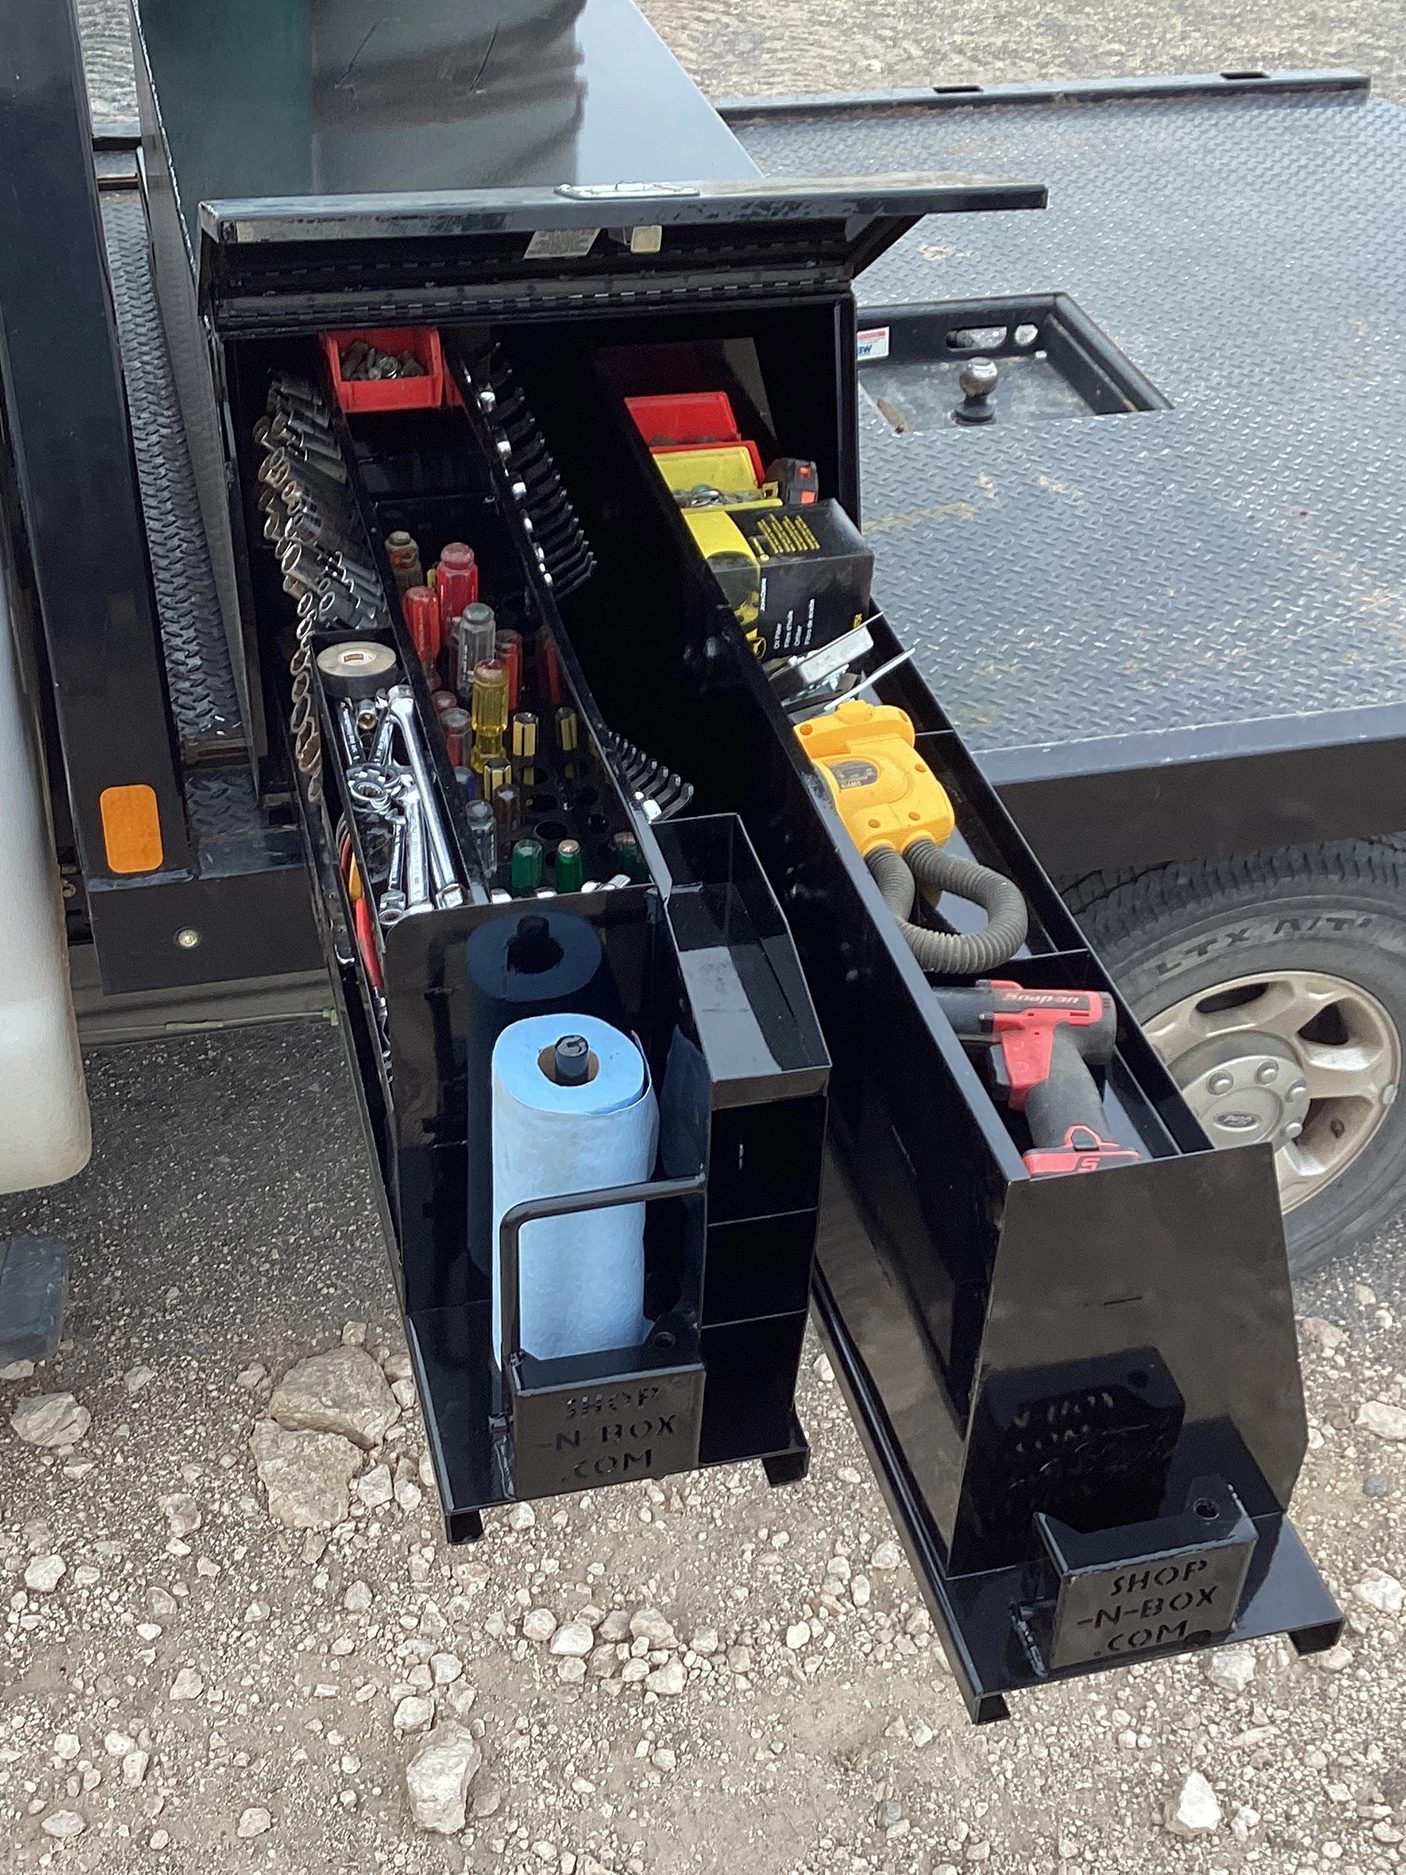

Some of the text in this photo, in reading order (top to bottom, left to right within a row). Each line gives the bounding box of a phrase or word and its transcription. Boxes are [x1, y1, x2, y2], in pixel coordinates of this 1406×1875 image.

[1154, 927, 1251, 976] LTX
[566, 1387, 660, 1419] SHOP
[561, 1448, 653, 1483] .COM
[1110, 1560, 1208, 1596] SHOP
[1077, 1585, 1218, 1629] -N-BOX
[1094, 1619, 1188, 1657] .COM
